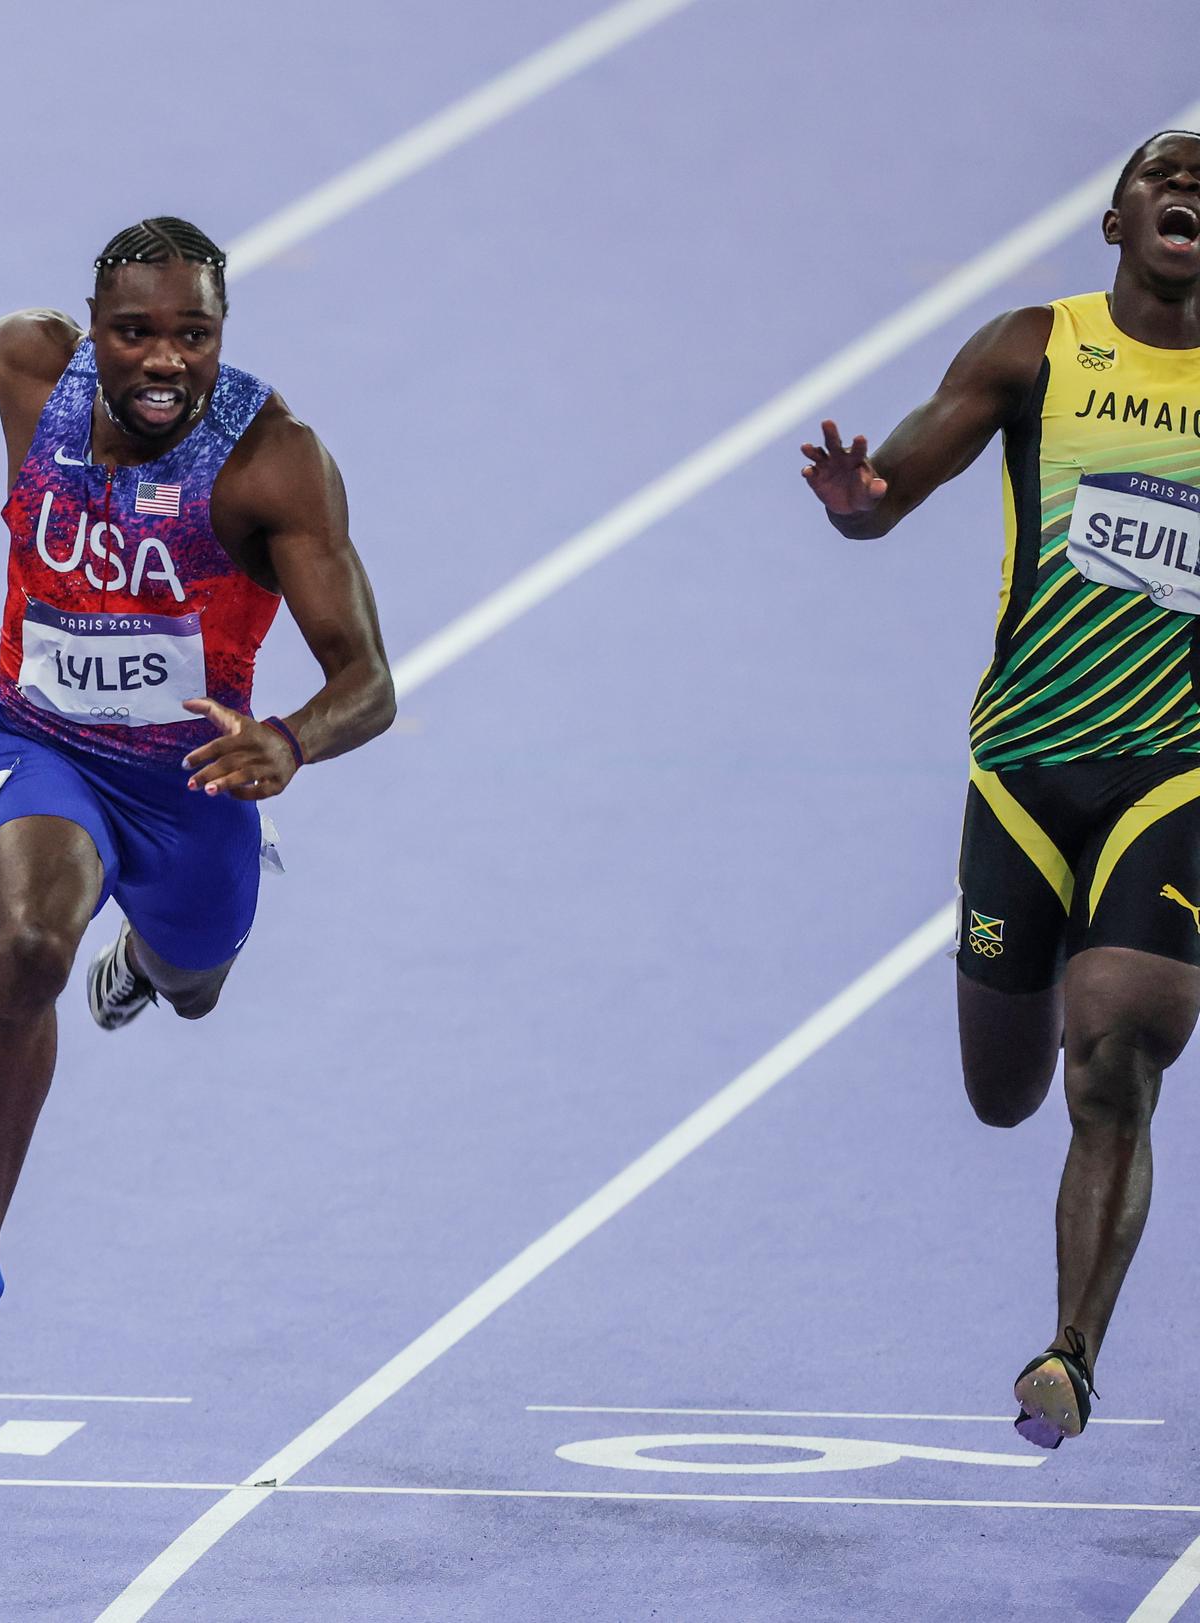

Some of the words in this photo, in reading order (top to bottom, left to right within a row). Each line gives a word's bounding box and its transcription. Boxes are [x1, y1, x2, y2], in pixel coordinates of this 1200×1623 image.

[36, 491, 186, 602] USA
[60, 616, 103, 631] PARIS
[108, 620, 151, 631] 2024
[55, 649, 168, 692] LYLES
